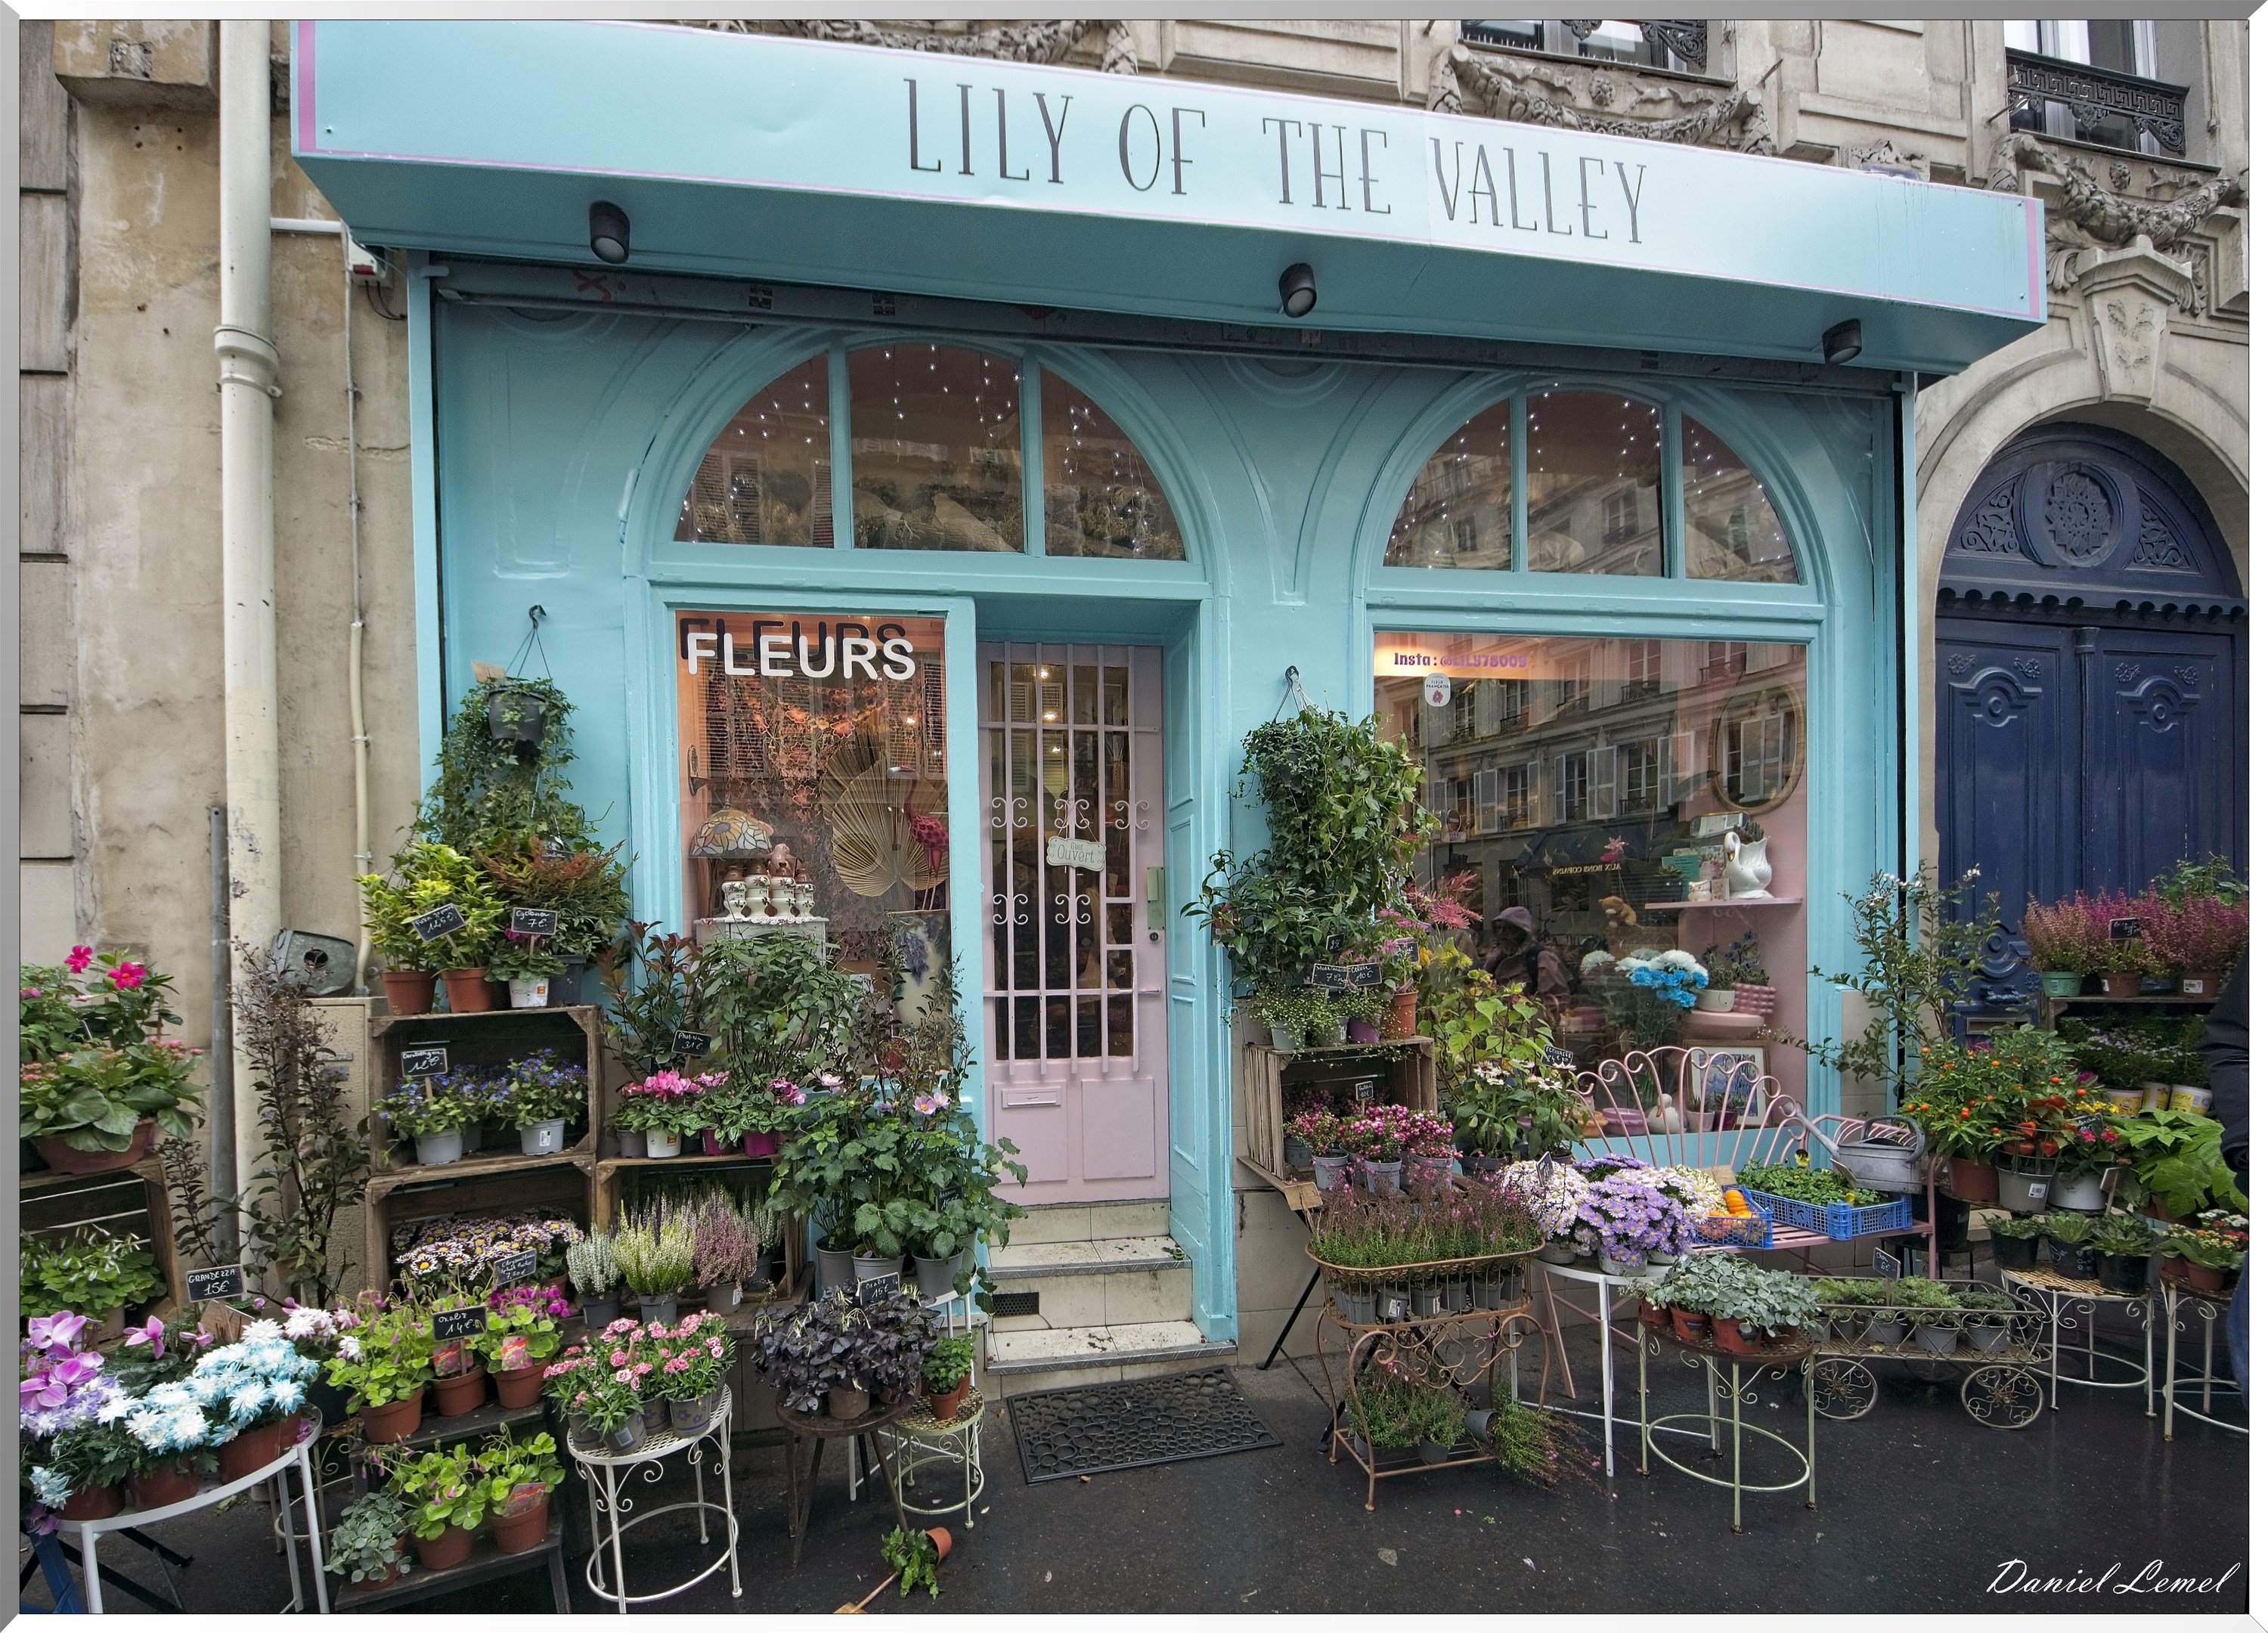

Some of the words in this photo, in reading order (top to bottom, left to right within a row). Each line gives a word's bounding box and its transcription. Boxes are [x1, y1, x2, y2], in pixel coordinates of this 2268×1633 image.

[903, 78, 1074, 184] LILY
[1119, 103, 1206, 196] OF
[1263, 116, 1392, 215] THE
[1429, 137, 1647, 243] VALLEY
[687, 632, 916, 680] FLEURS
[1058, 844, 1095, 863] Ouvert
[188, 1269, 235, 1284] GRANDEZZA
[203, 1280, 230, 1296] 15€
